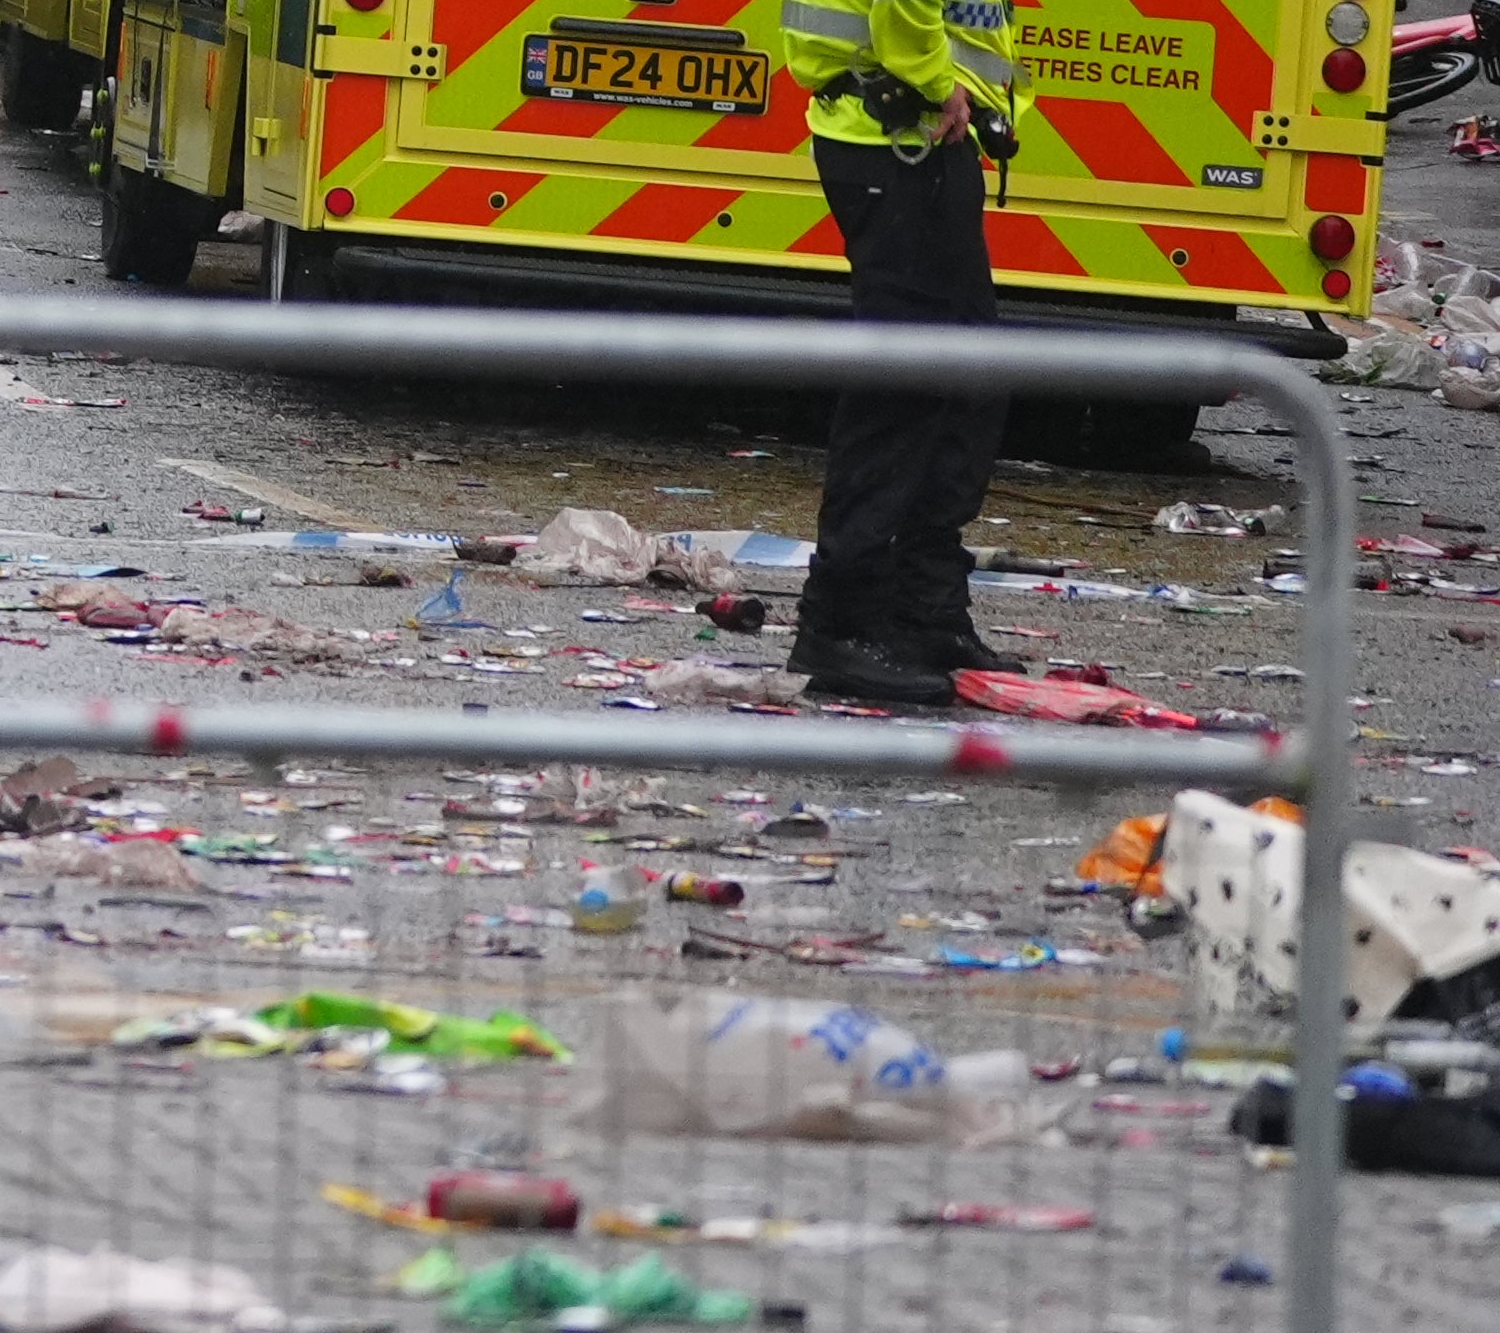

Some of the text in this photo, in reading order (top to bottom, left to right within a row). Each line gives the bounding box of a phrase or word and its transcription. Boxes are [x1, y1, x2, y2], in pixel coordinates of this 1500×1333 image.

[1014, 25, 1183, 58] EASE LEAVE
[527, 70, 544, 81] GB
[553, 44, 760, 99] DF24 OHX
[1019, 56, 1200, 91] ETRES CLEAR
[593, 92, 694, 108] www.was-vehicles.com
[1206, 167, 1255, 185] WAS
